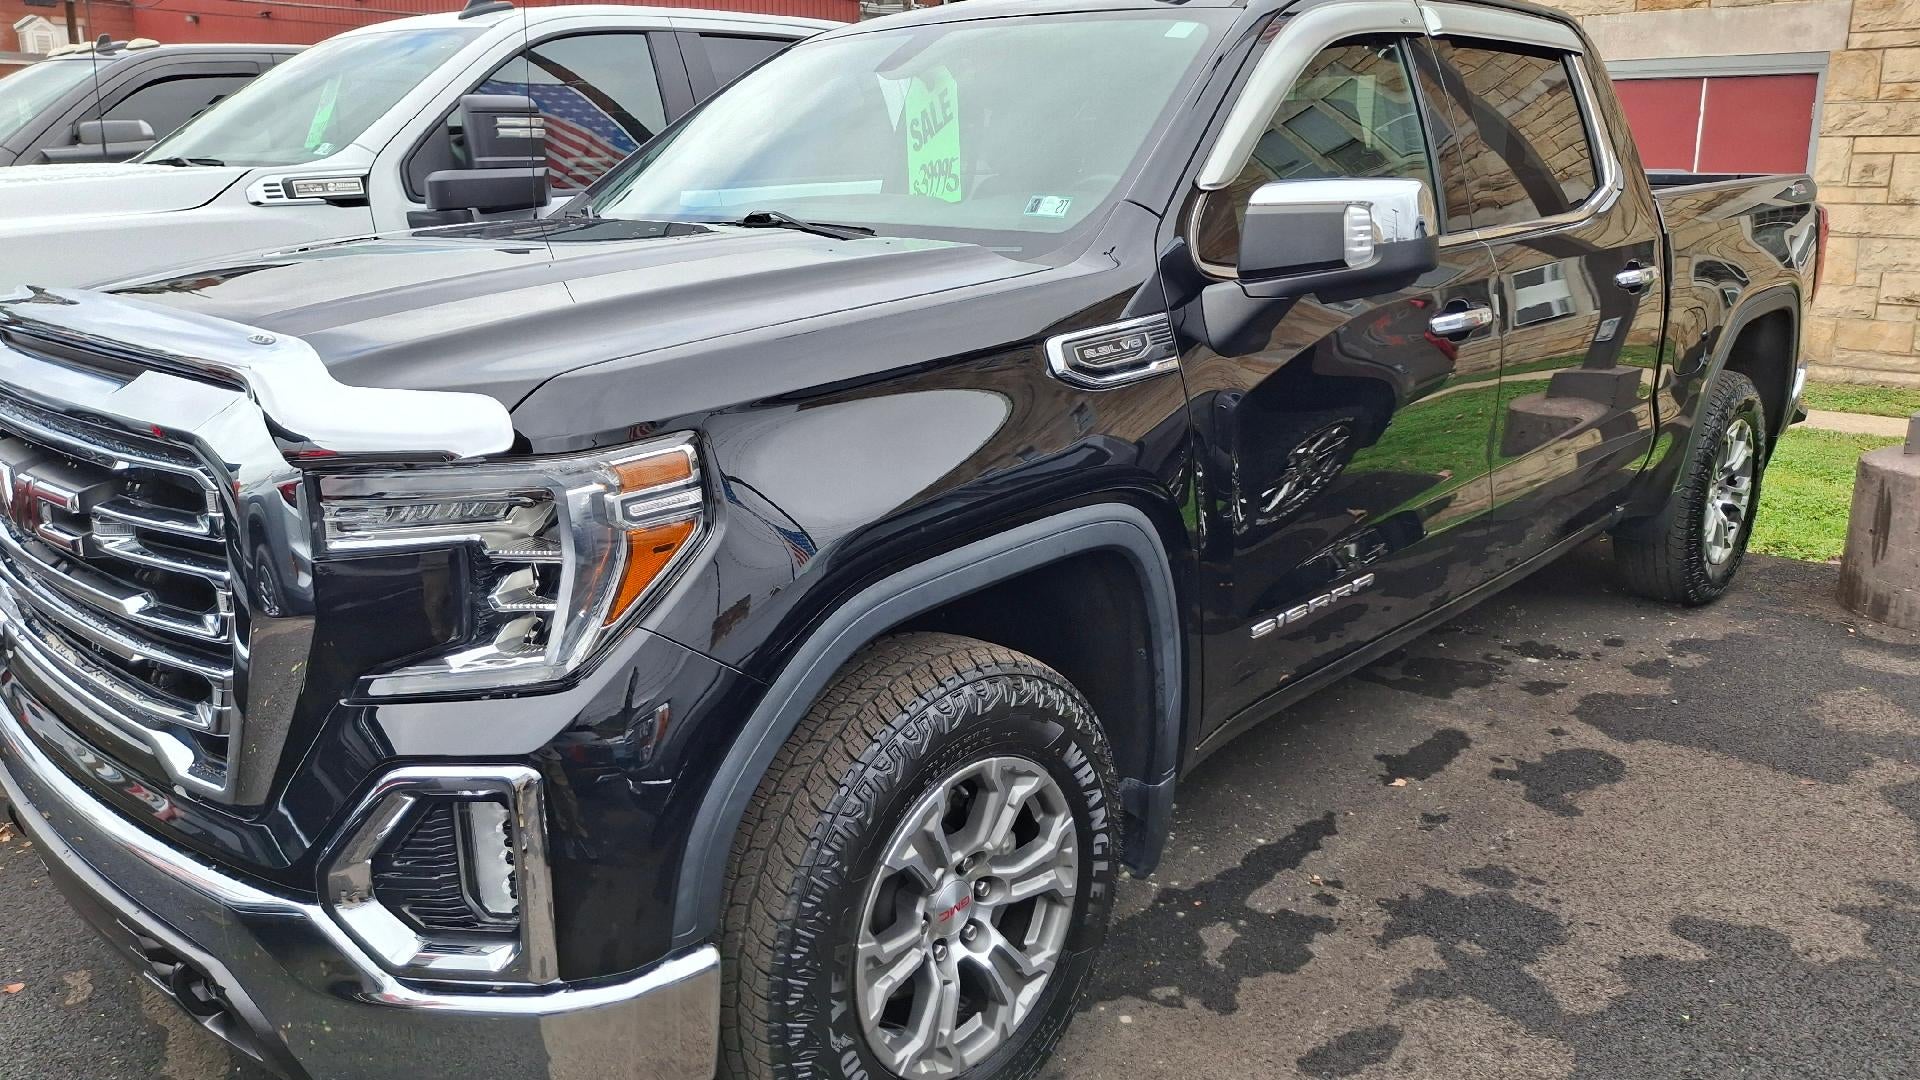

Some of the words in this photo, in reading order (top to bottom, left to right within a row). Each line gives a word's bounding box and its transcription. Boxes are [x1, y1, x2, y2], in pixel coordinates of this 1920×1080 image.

[910, 88, 953, 151] SALE
[1055, 199, 1070, 213] 27
[1250, 572, 1375, 639] SIERRA
[939, 895, 970, 922] GMC
